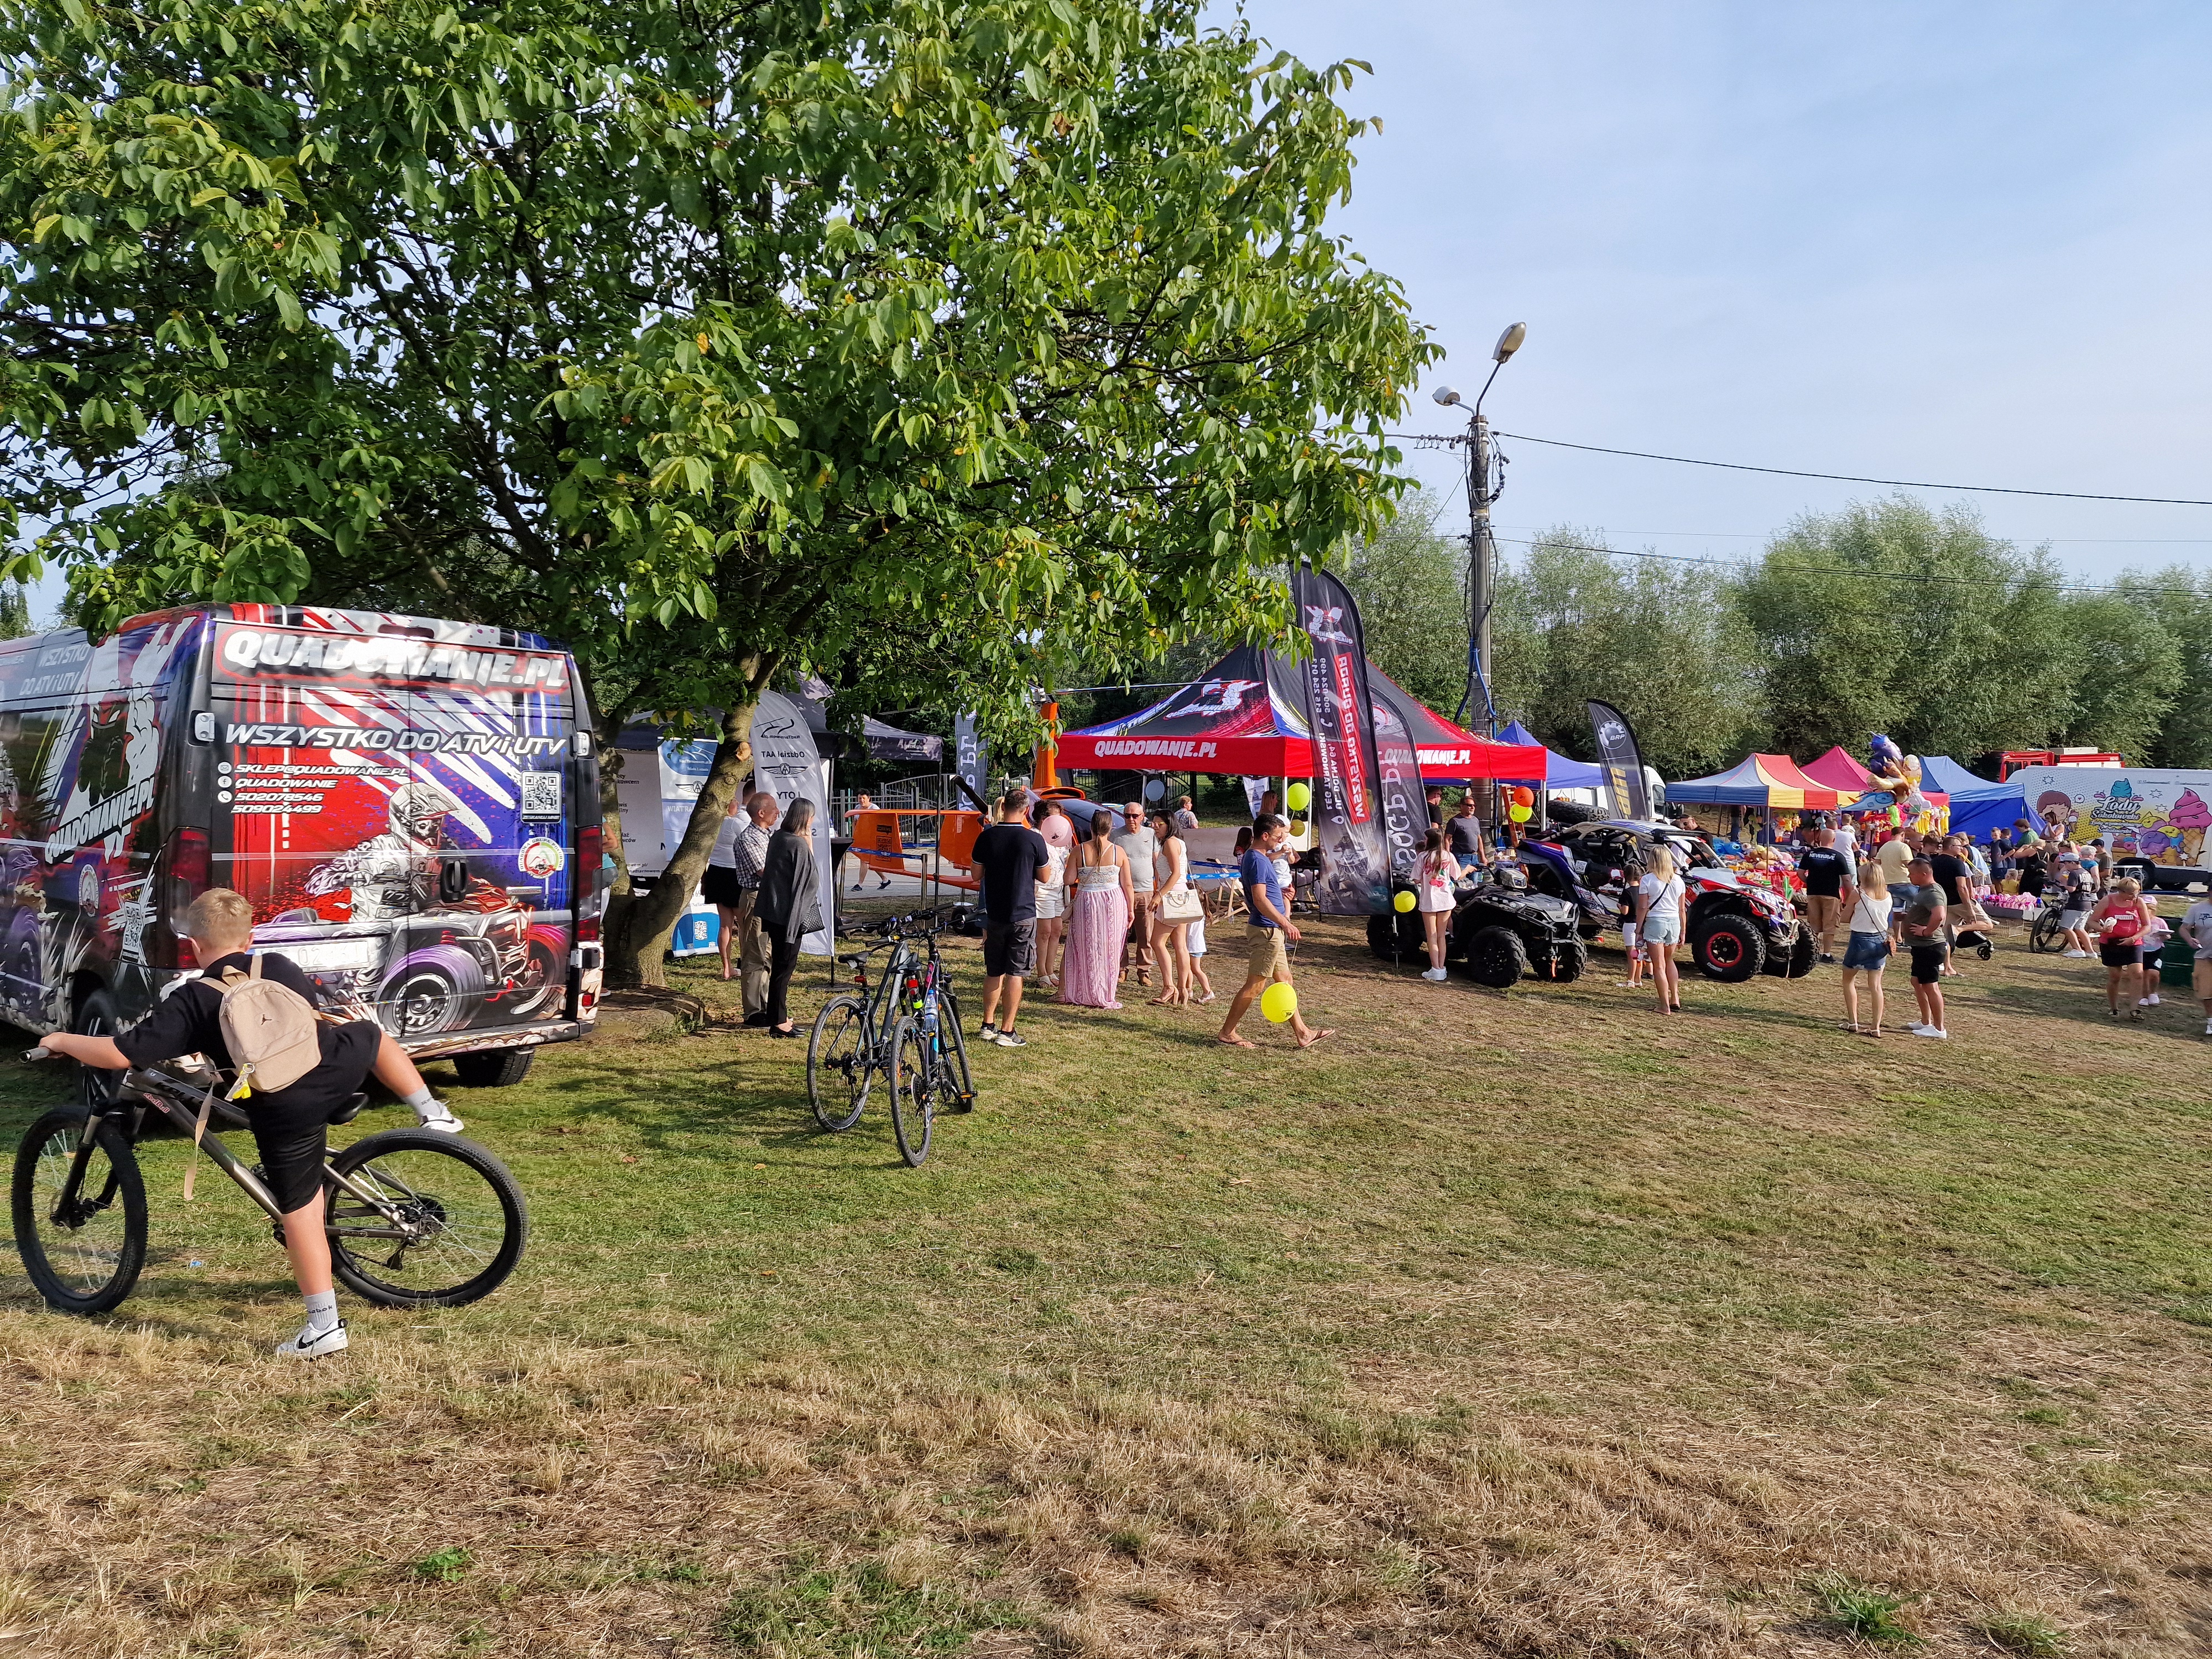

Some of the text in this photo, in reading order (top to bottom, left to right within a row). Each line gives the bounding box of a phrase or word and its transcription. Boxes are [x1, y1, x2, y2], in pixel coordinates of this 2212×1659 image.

[39, 644, 90, 667] WSZYSTKO
[224, 630, 567, 688] QUADOWANIE.PL
[226, 723, 566, 755] WSZYSTKO DO ATV i UTV
[1094, 740, 1217, 759] QUADOWANIE.PL
[234, 764, 408, 776] SKLEP@QUADOWANIE.PL
[235, 778, 338, 789] QUADOWANIE
[234, 792, 325, 802] 502078546
[2094, 795, 2141, 813] Lody
[231, 805, 323, 813] 509024499
[45, 776, 155, 864] QUADOWANIE.PL
